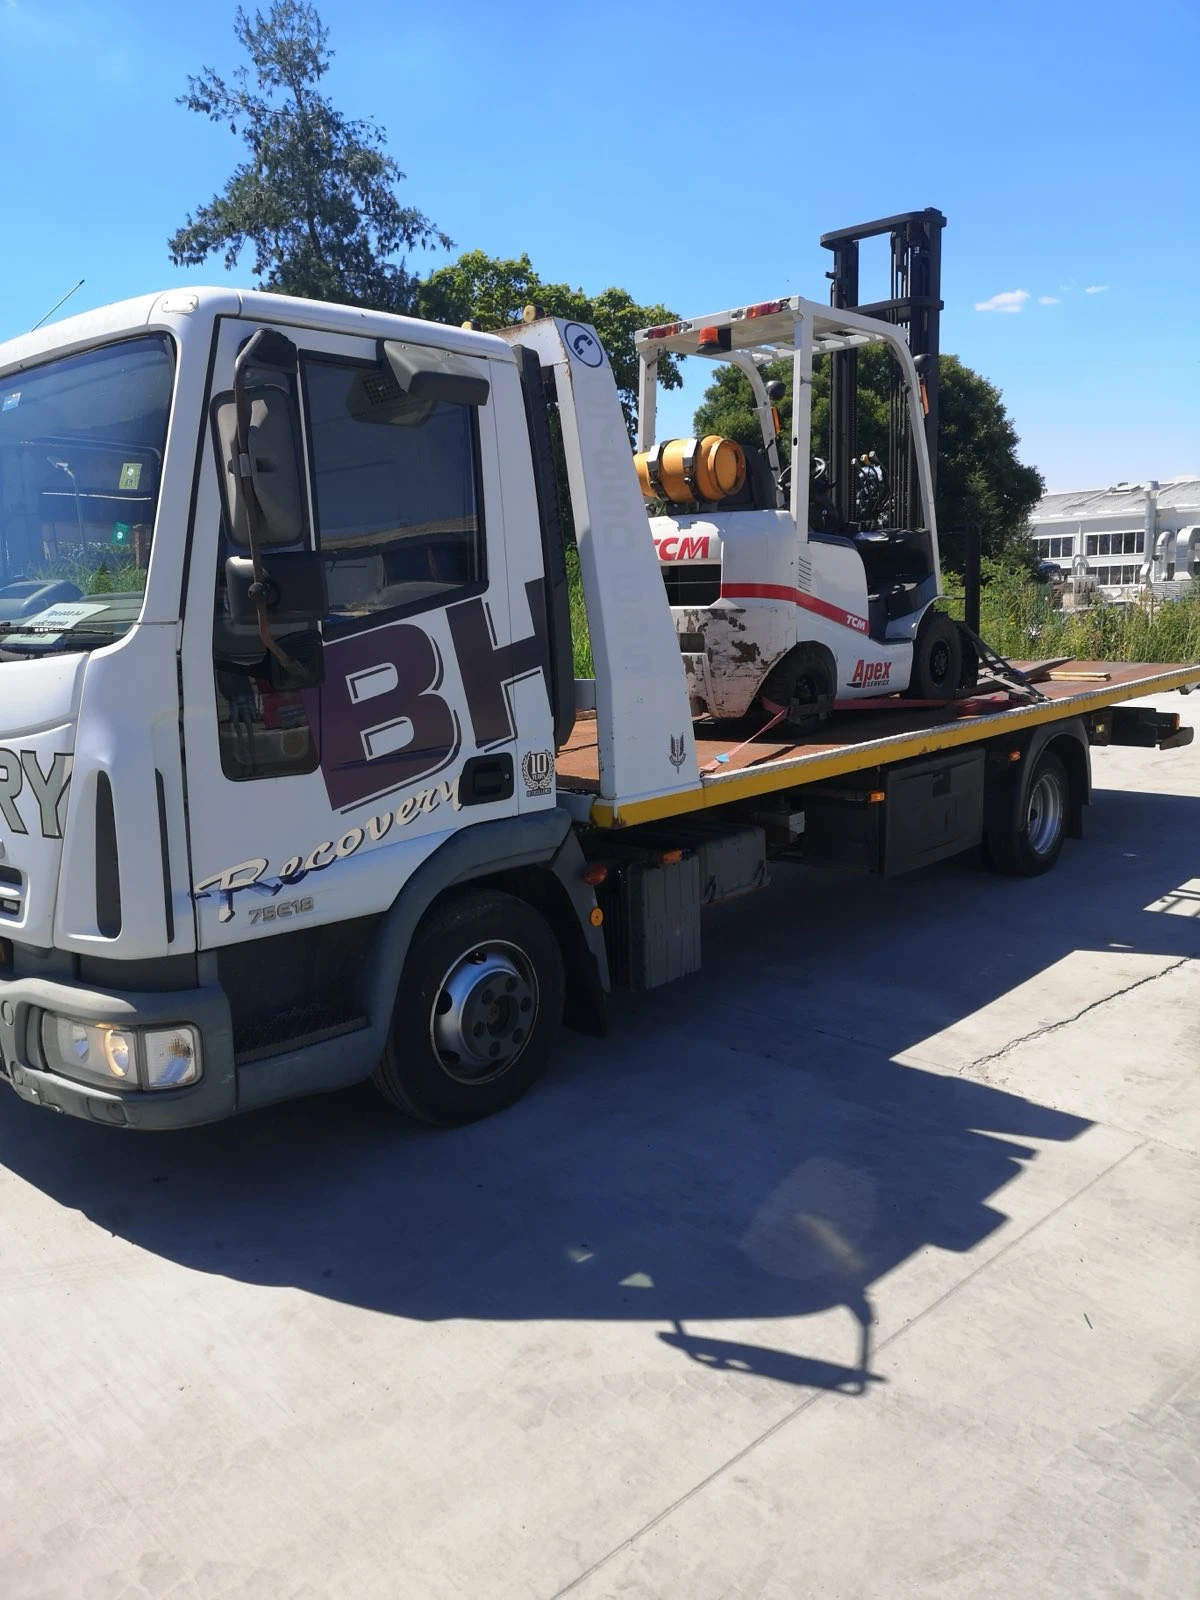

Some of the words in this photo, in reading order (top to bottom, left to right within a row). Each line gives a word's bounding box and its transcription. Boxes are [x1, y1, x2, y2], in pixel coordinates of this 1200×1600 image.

[846, 614, 866, 631] TCM
[852, 659, 892, 688] Apex
[866, 679, 890, 688] SERVICE
[302, 577, 553, 816] BH
[530, 753, 547, 775] 10
[188, 773, 464, 923] Recovery
[248, 896, 315, 925] 75E18
